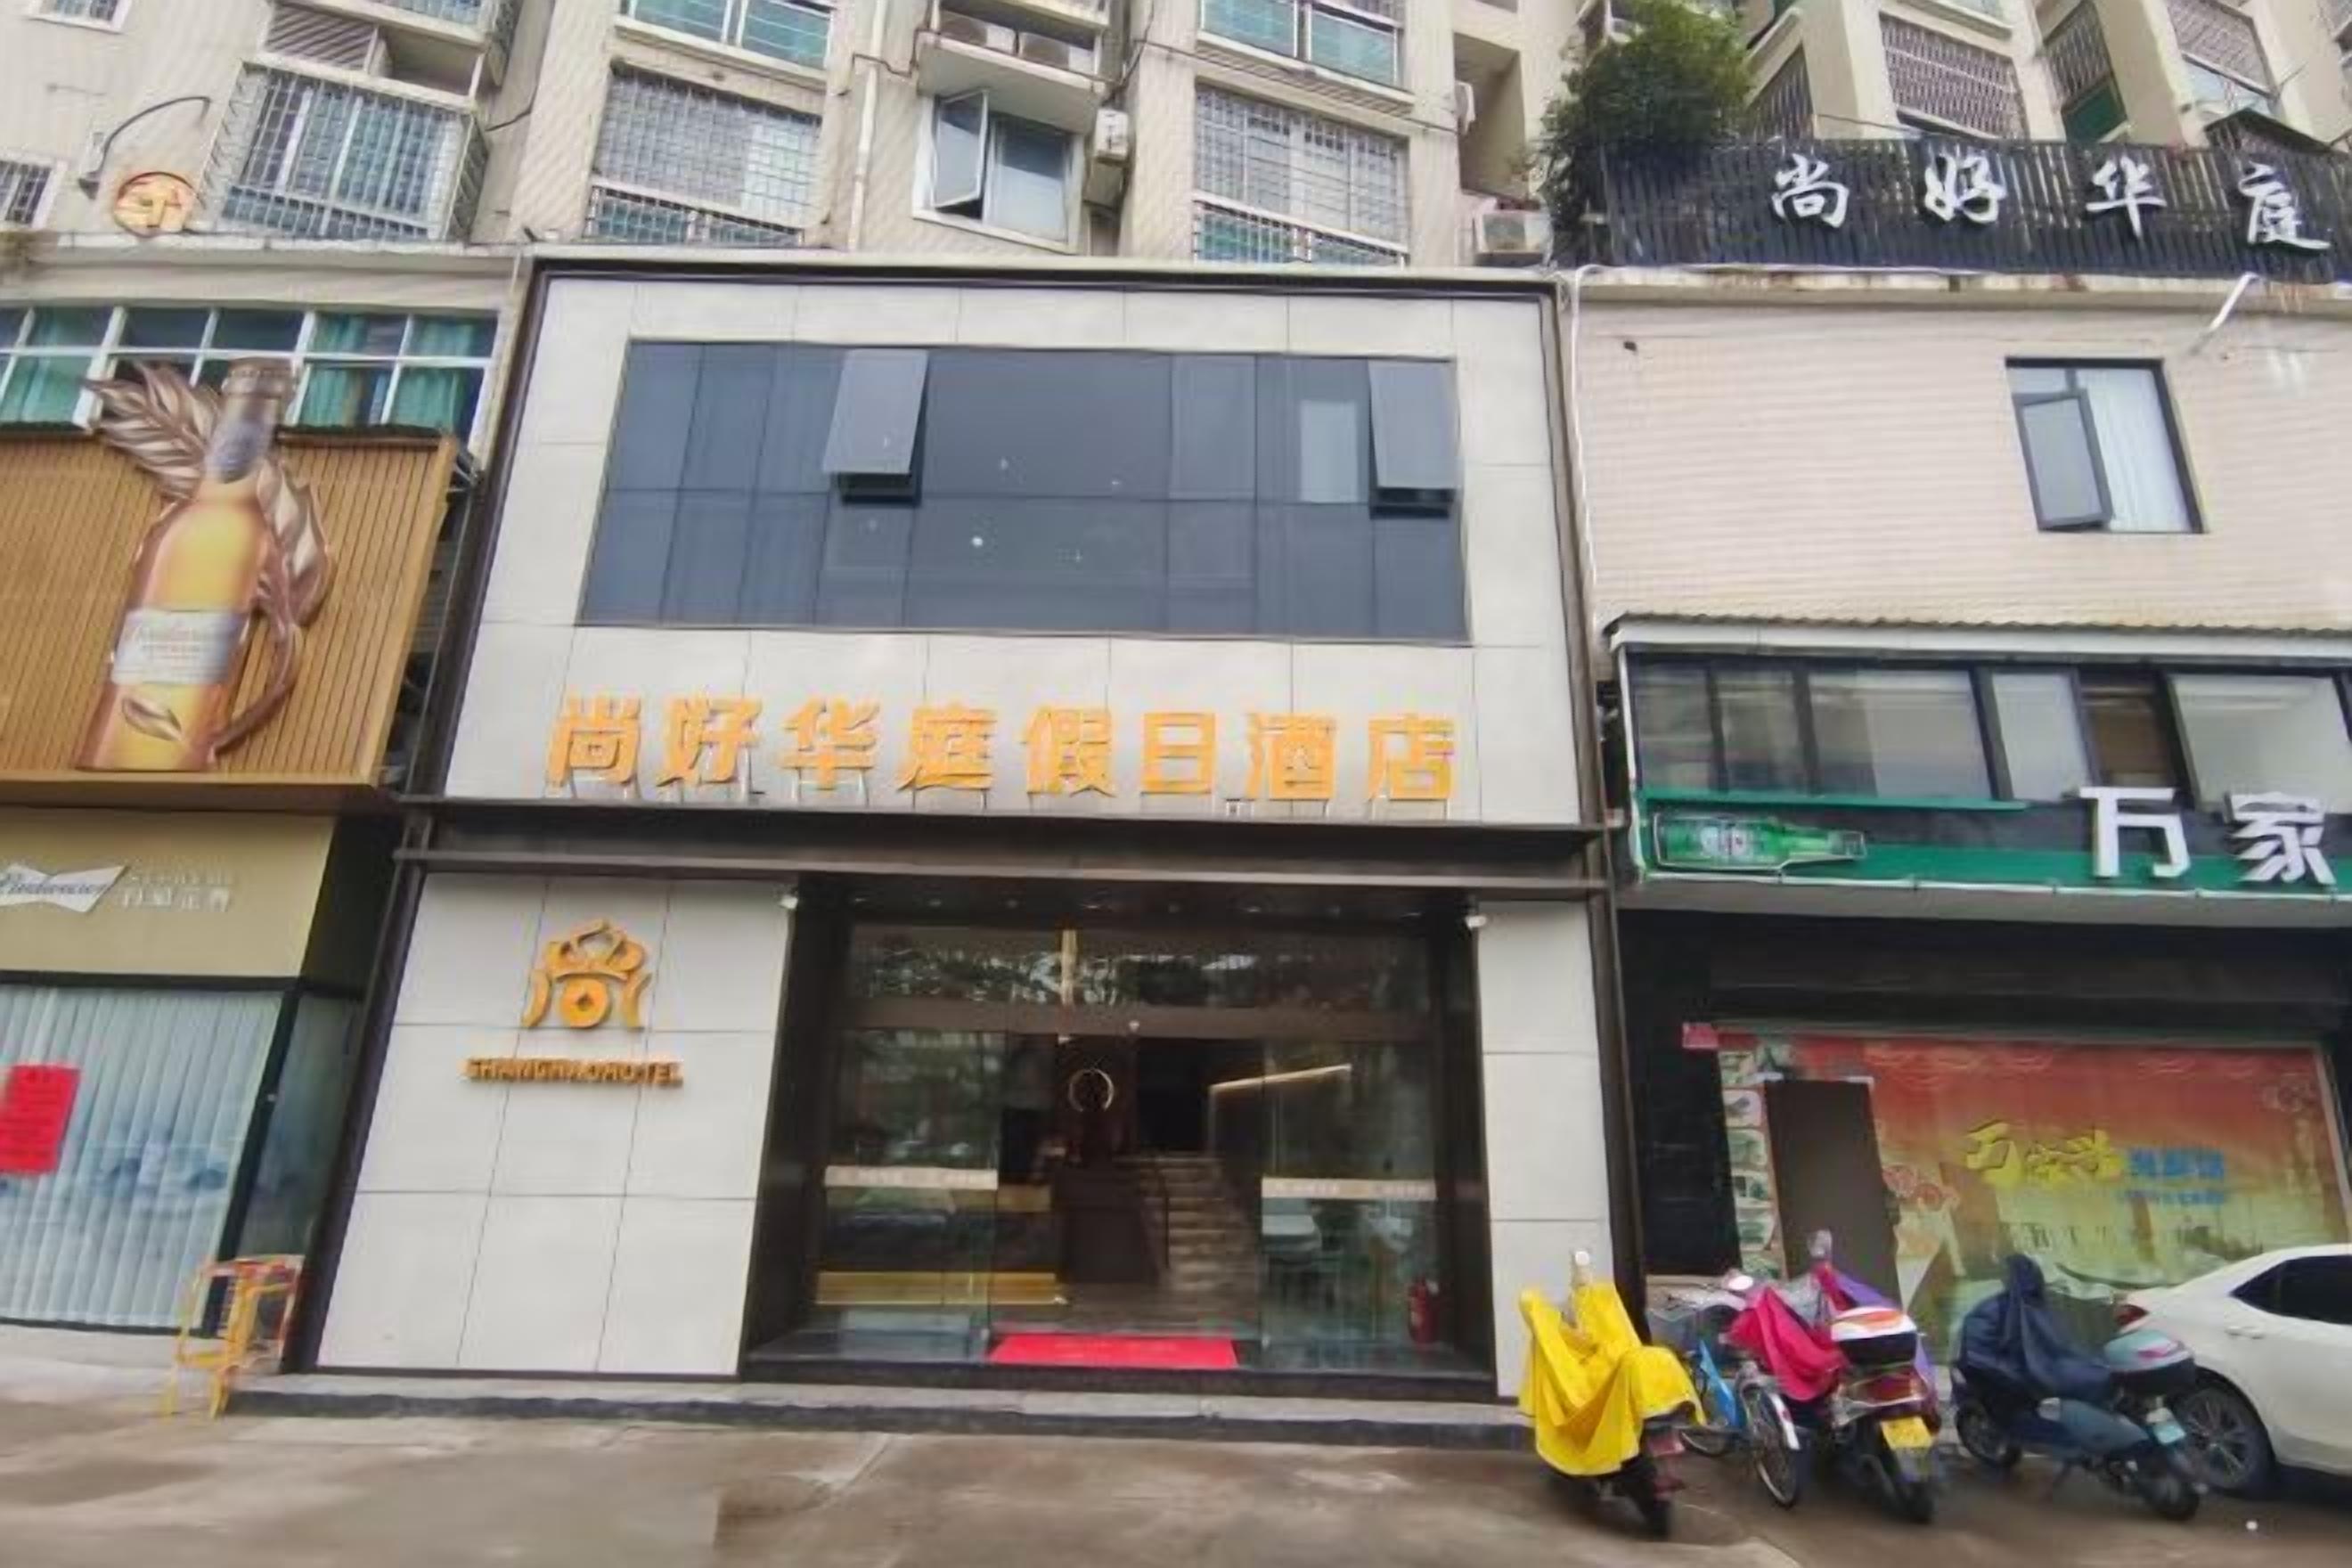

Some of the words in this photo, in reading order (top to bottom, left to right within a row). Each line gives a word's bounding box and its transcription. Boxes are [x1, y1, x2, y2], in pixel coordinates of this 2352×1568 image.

[1773, 151, 2331, 250] 尚好华庭
[545, 697, 1458, 802] 尚好华庭假日酒店
[2078, 785, 2337, 886] 万家
